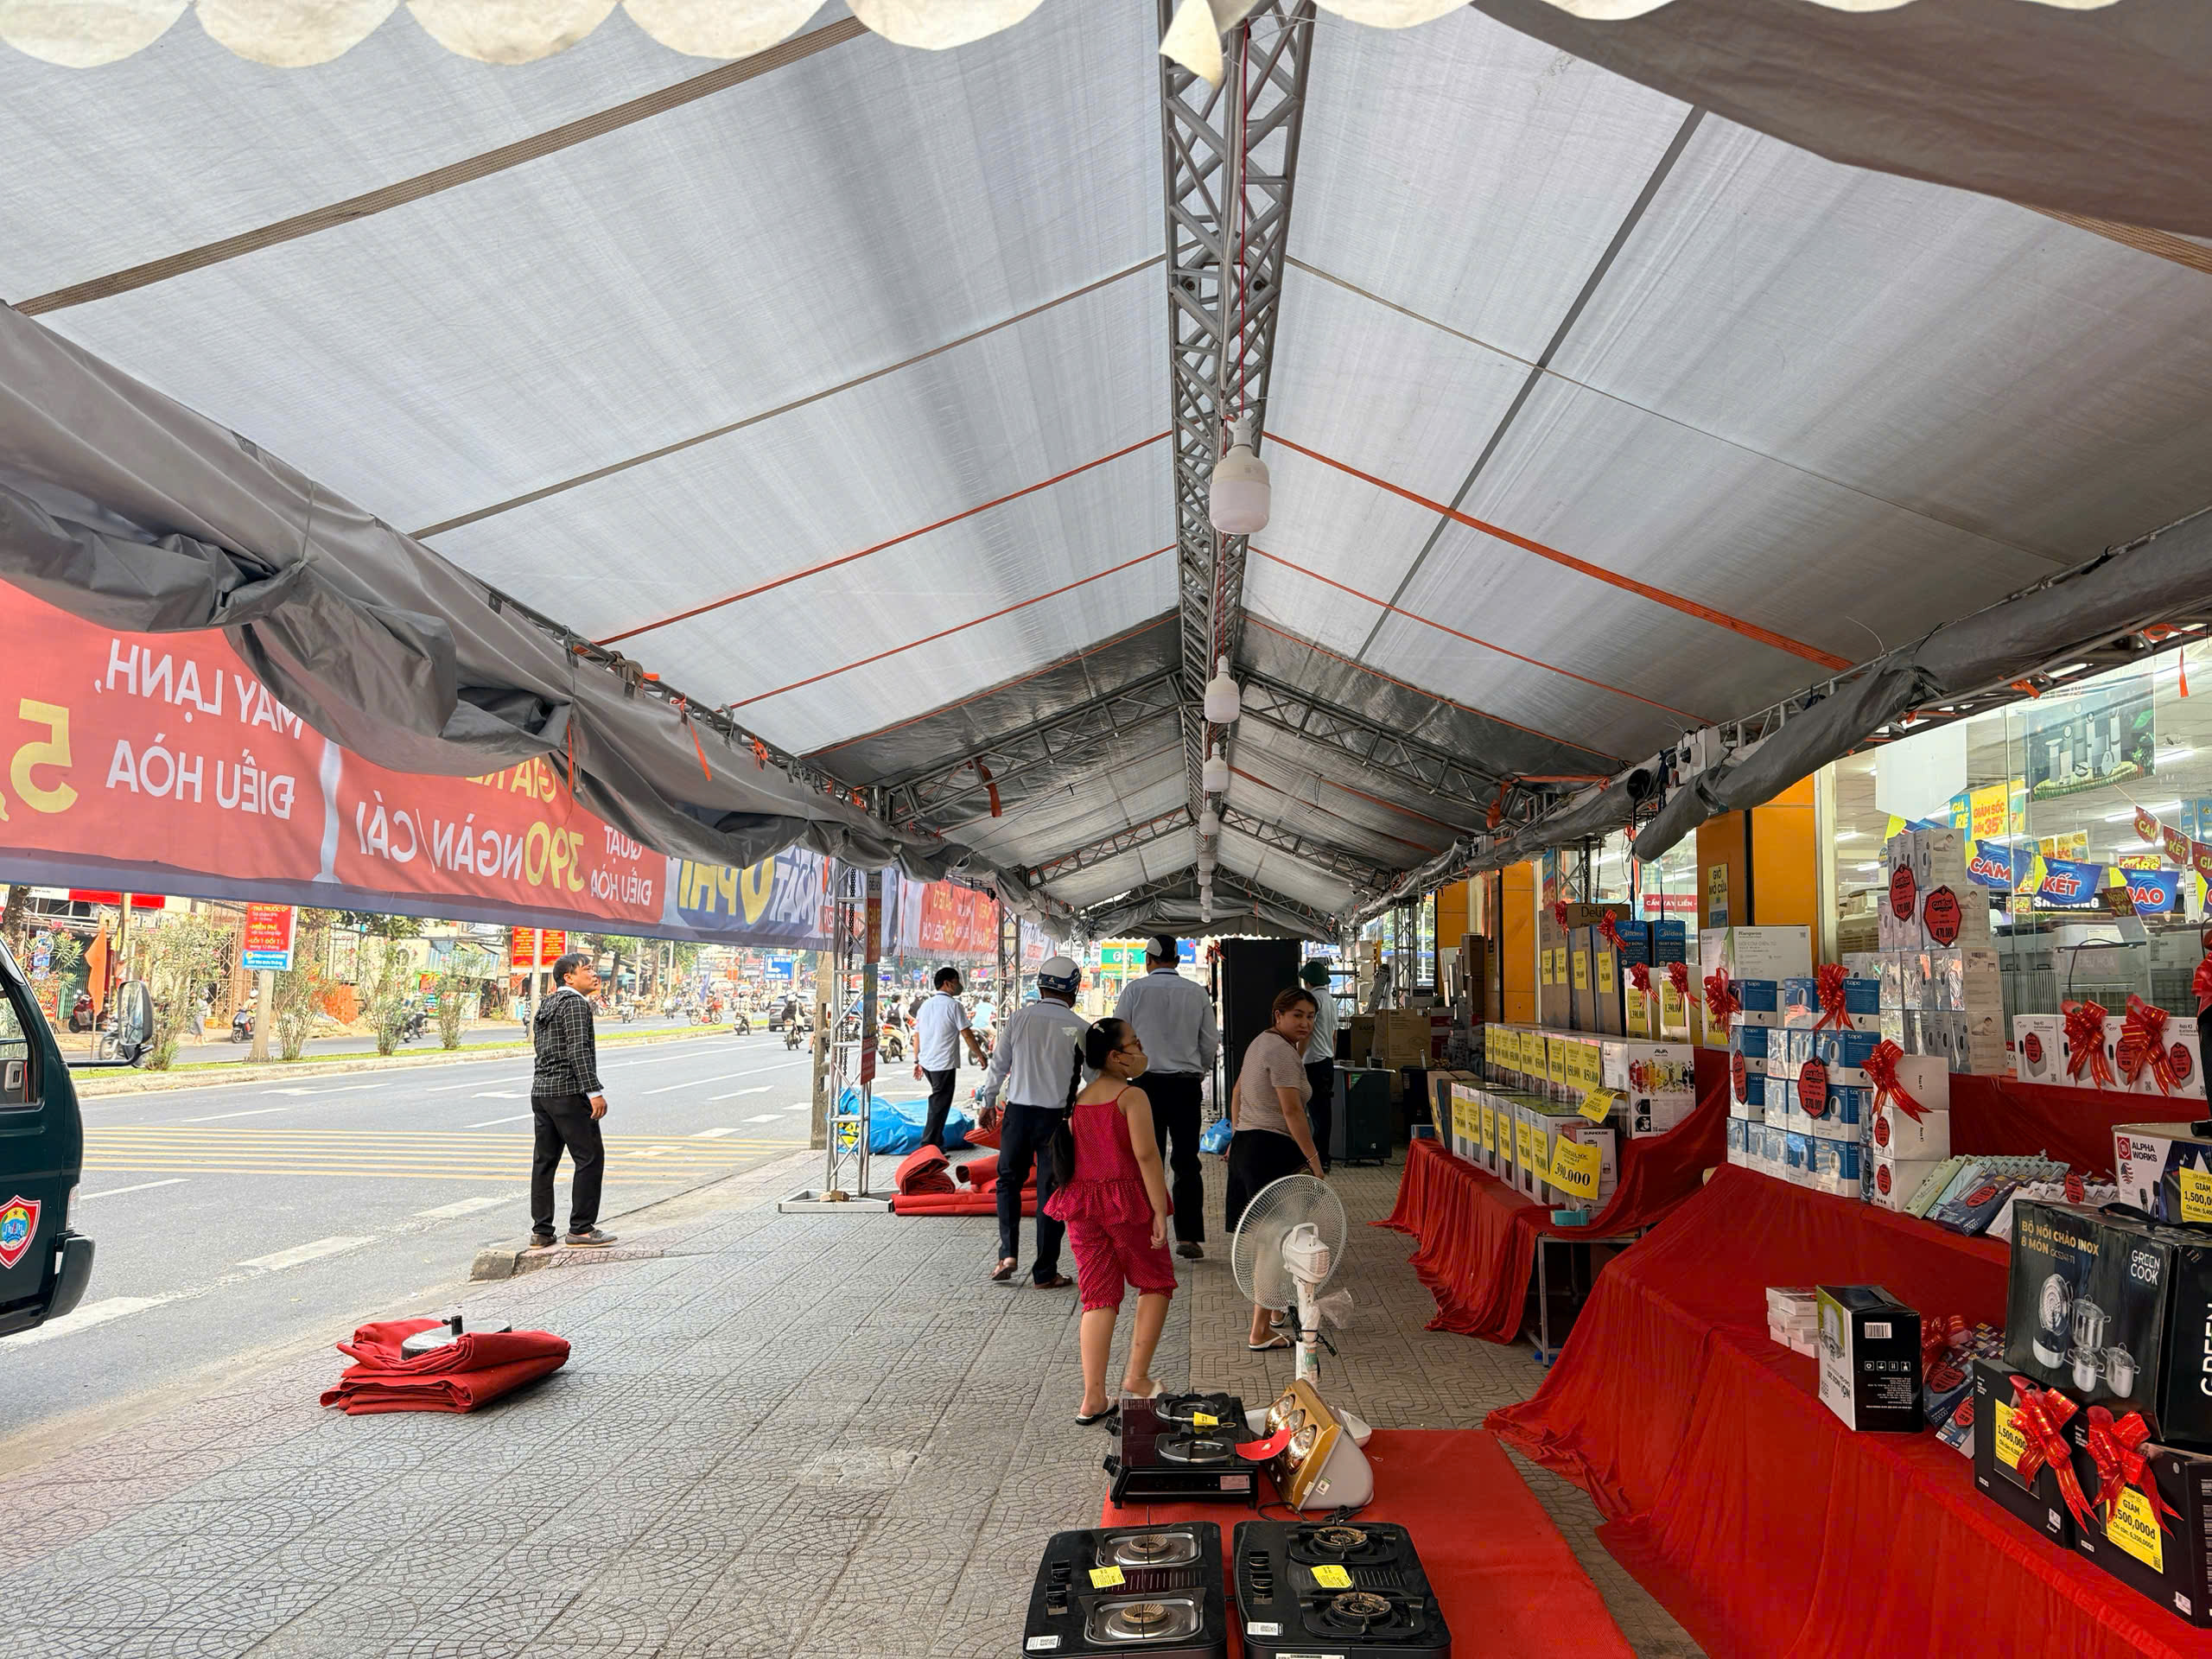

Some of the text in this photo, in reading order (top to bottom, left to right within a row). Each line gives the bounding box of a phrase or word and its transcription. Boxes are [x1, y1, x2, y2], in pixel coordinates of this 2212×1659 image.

[1974, 800, 2005, 819] GIẢM SỐC
[2169, 841, 2186, 858] KẾT
[1970, 856, 2012, 882] CAM
[2042, 873, 2082, 896] KẾT
[2127, 887, 2165, 905] BAO
[2132, 1141, 2156, 1153] ALPHA
[2133, 1151, 2158, 1162] WORKS
[2020, 1236, 2027, 1247] 8
[2028, 1237, 2050, 1254] MÓN
[2022, 1220, 2100, 1256] BỘ NỒI CHẢO INOX
[2132, 1249, 2161, 1270] GREEN
[2130, 1263, 2158, 1286] COOK
[2123, 1500, 2140, 1516] GIẢM
[2114, 1509, 2156, 1540] ,500,000đ
